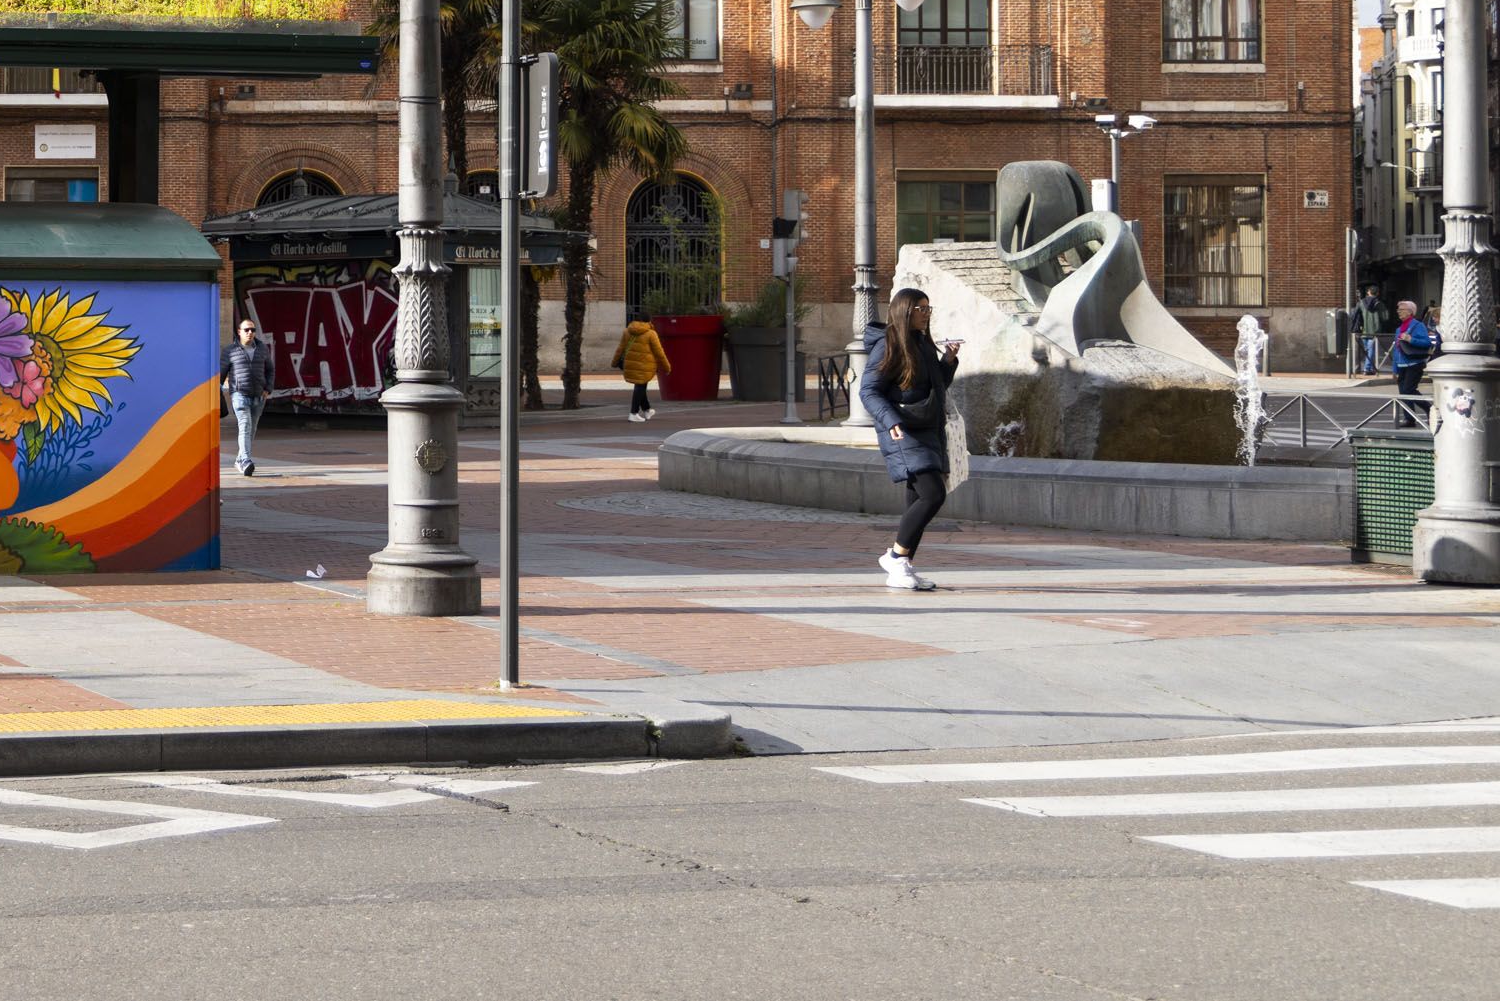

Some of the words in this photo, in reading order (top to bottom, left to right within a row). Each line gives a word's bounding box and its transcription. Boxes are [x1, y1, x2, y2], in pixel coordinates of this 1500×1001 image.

[270, 243, 281, 256] El
[283, 243, 304, 256] Norte
[306, 243, 315, 255] de
[316, 241, 348, 255] Castilla
[455, 246, 466, 258] El
[468, 246, 489, 259] Norte
[490, 247, 500, 259] de
